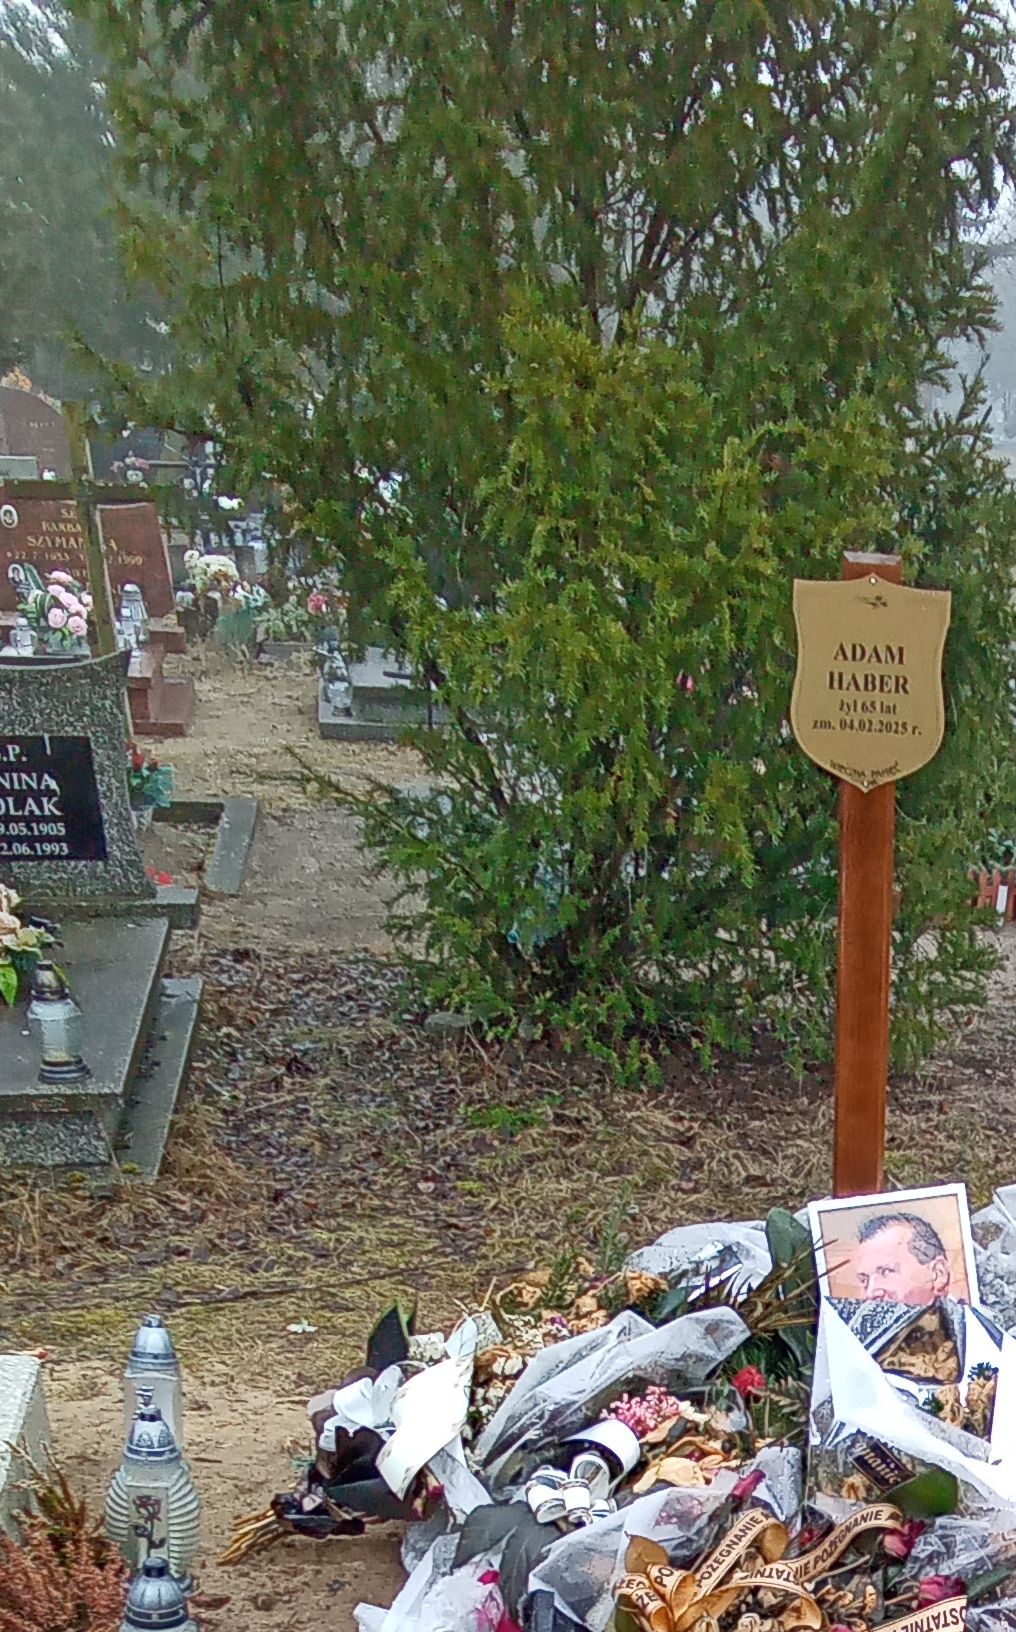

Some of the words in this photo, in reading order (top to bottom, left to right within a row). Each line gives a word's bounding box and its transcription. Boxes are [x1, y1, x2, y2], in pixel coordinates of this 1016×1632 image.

[833, 641, 905, 665] ADAM
[828, 670, 909, 695] HABER
[860, 700, 877, 714] 65
[880, 701, 897, 715] lat
[812, 719, 836, 731] zm.
[839, 718, 908, 735] 04.02.2025
[911, 725, 922, 736] r.
